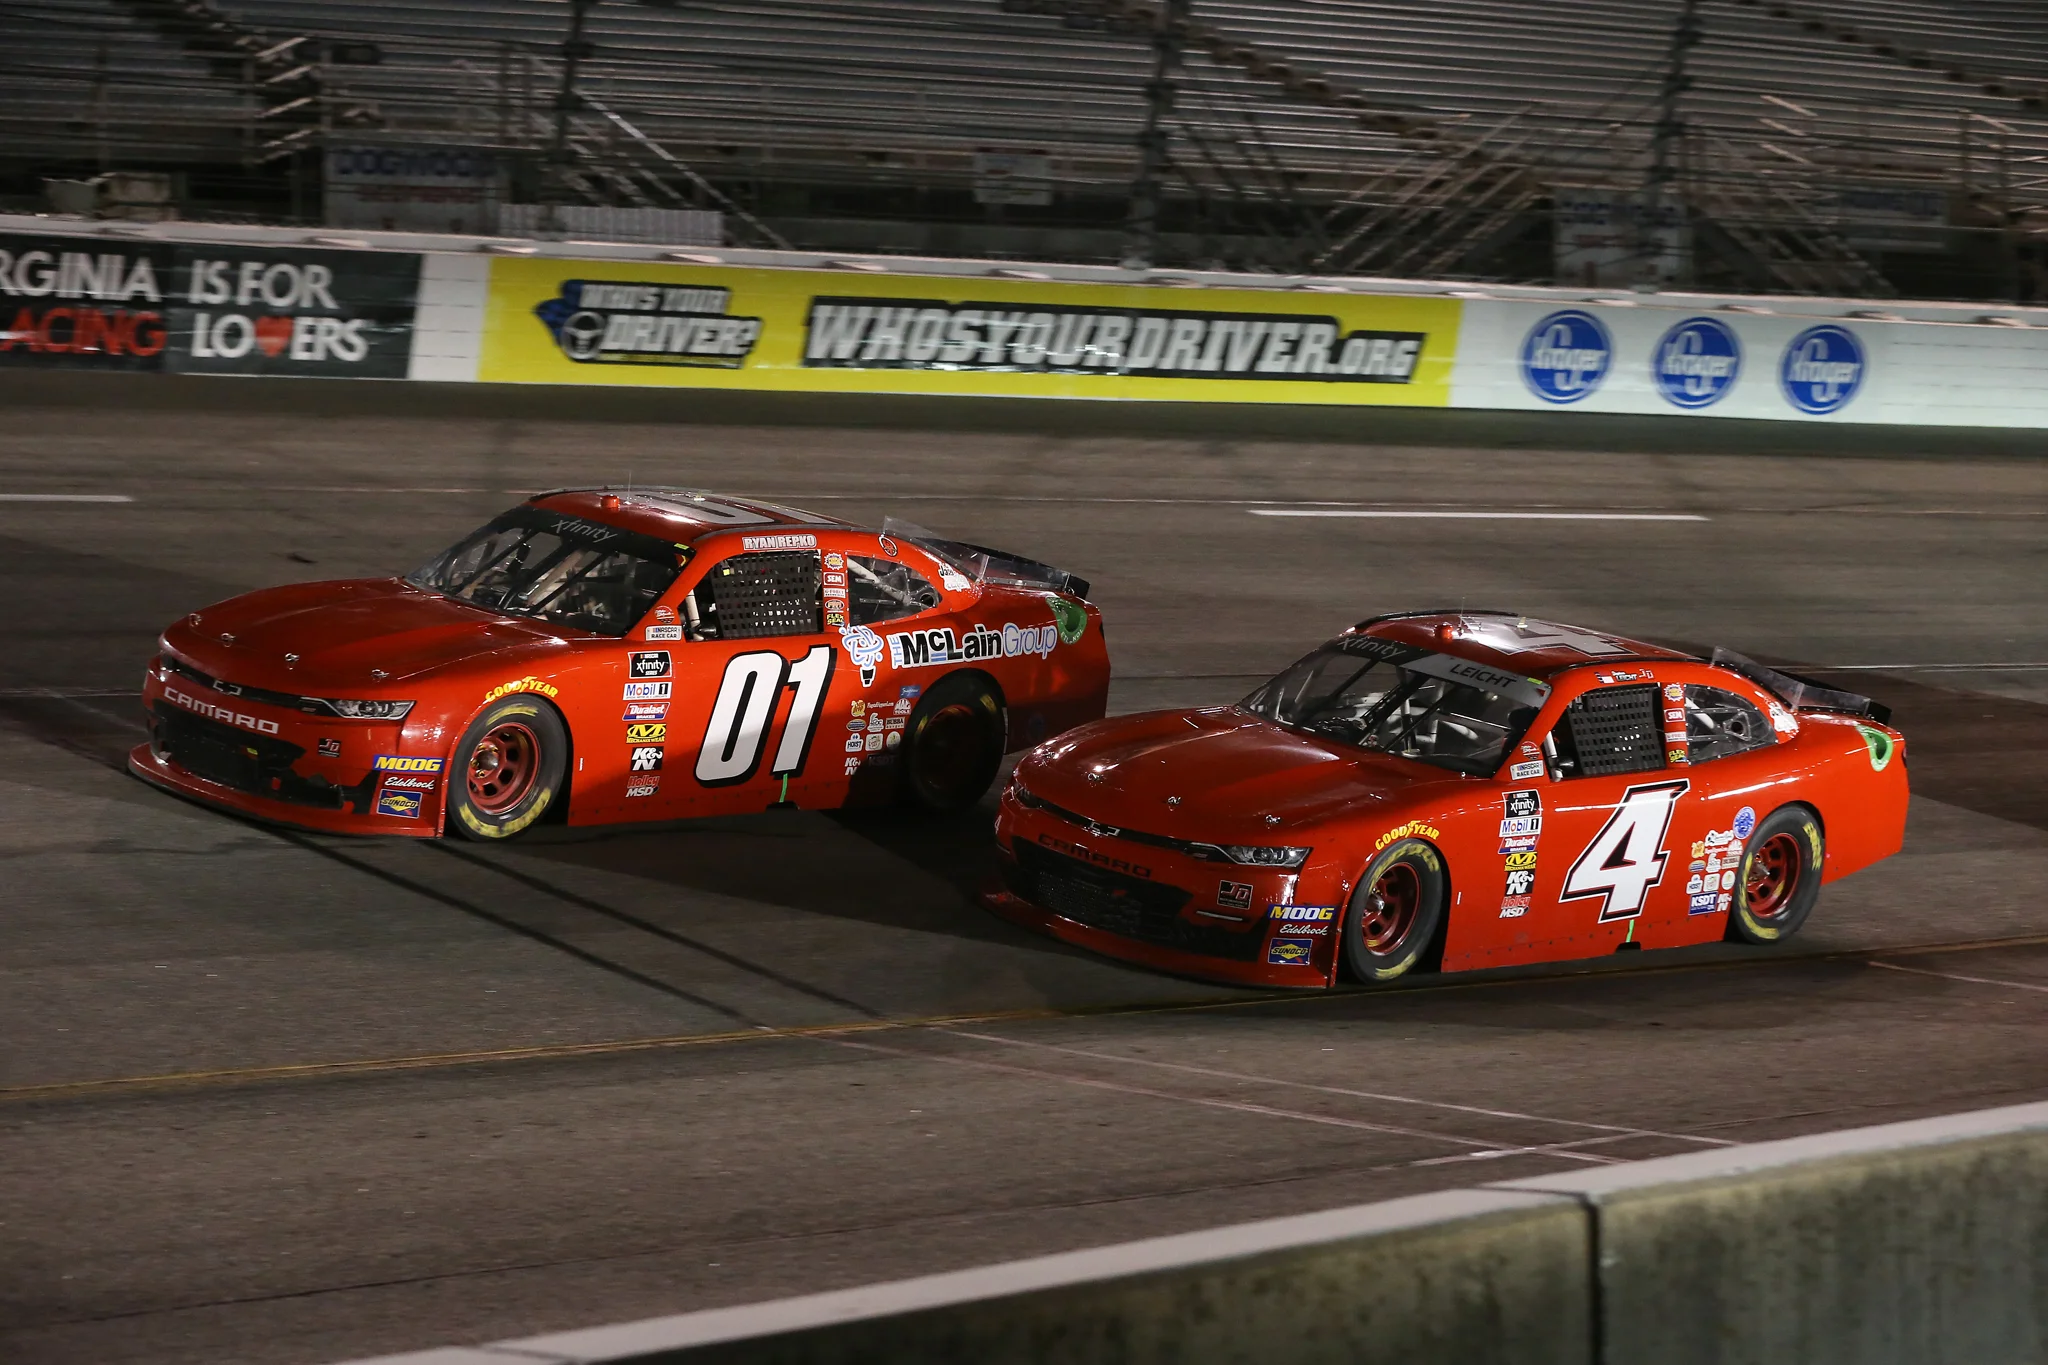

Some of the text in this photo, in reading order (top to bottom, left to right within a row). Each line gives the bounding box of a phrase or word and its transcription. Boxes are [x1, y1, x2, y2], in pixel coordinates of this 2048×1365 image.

[188, 260, 340, 309] IS FOR
[551, 519, 618, 543] xfinity
[743, 534, 817, 550] RYAN REPKO
[889, 636, 901, 666] THE
[1337, 636, 1407, 659] xfinity
[636, 660, 665, 674] xfinity
[1450, 662, 1517, 688] LEICHT
[485, 675, 559, 702] GOODYEAR
[626, 683, 668, 697] Mobil 1
[163, 686, 279, 735] CAMARO
[629, 703, 666, 715] Duralast
[694, 644, 837, 788] 01
[375, 756, 442, 772] MOOG
[384, 776, 435, 790] Edelbrock
[626, 786, 654, 798] MSD
[381, 798, 419, 808] SUNOCO
[1510, 799, 1535, 814] xfinity
[1502, 819, 1529, 833] Mobil
[1531, 818, 1539, 830] 1
[1375, 820, 1440, 851] GOODYEAR
[1504, 836, 1536, 848] Duralast
[1037, 832, 1152, 878] CAMARO
[1559, 778, 1690, 923] 4
[1691, 893, 1717, 908] KSDT
[1269, 906, 1335, 920] MOOG
[1499, 907, 1525, 919] MSD
[1279, 923, 1329, 936] Edelbrock
[1271, 947, 1309, 955] SUNOCO
